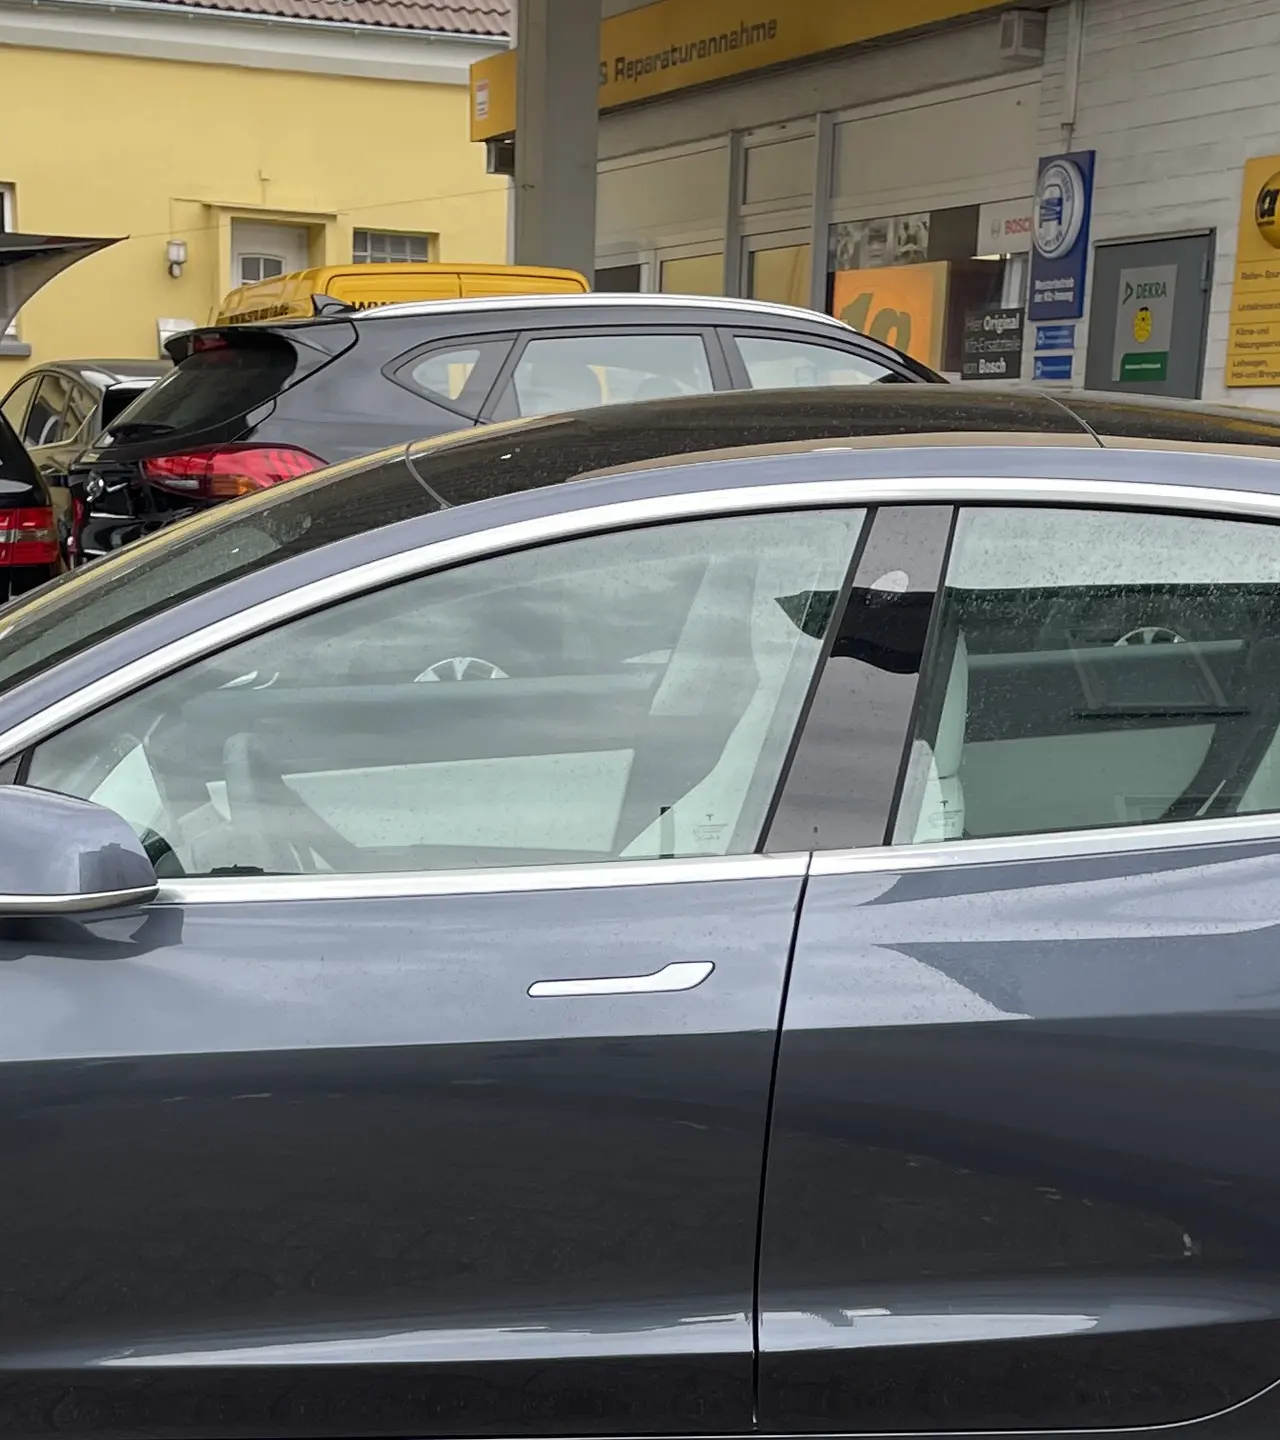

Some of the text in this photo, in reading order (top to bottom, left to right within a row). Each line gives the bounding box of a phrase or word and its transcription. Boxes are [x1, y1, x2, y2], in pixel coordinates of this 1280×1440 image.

[614, 18, 778, 83] Reparaturannahme
[1136, 281, 1168, 299] DEKRA
[983, 312, 1020, 334] Original
[978, 356, 1007, 374] Bosch
